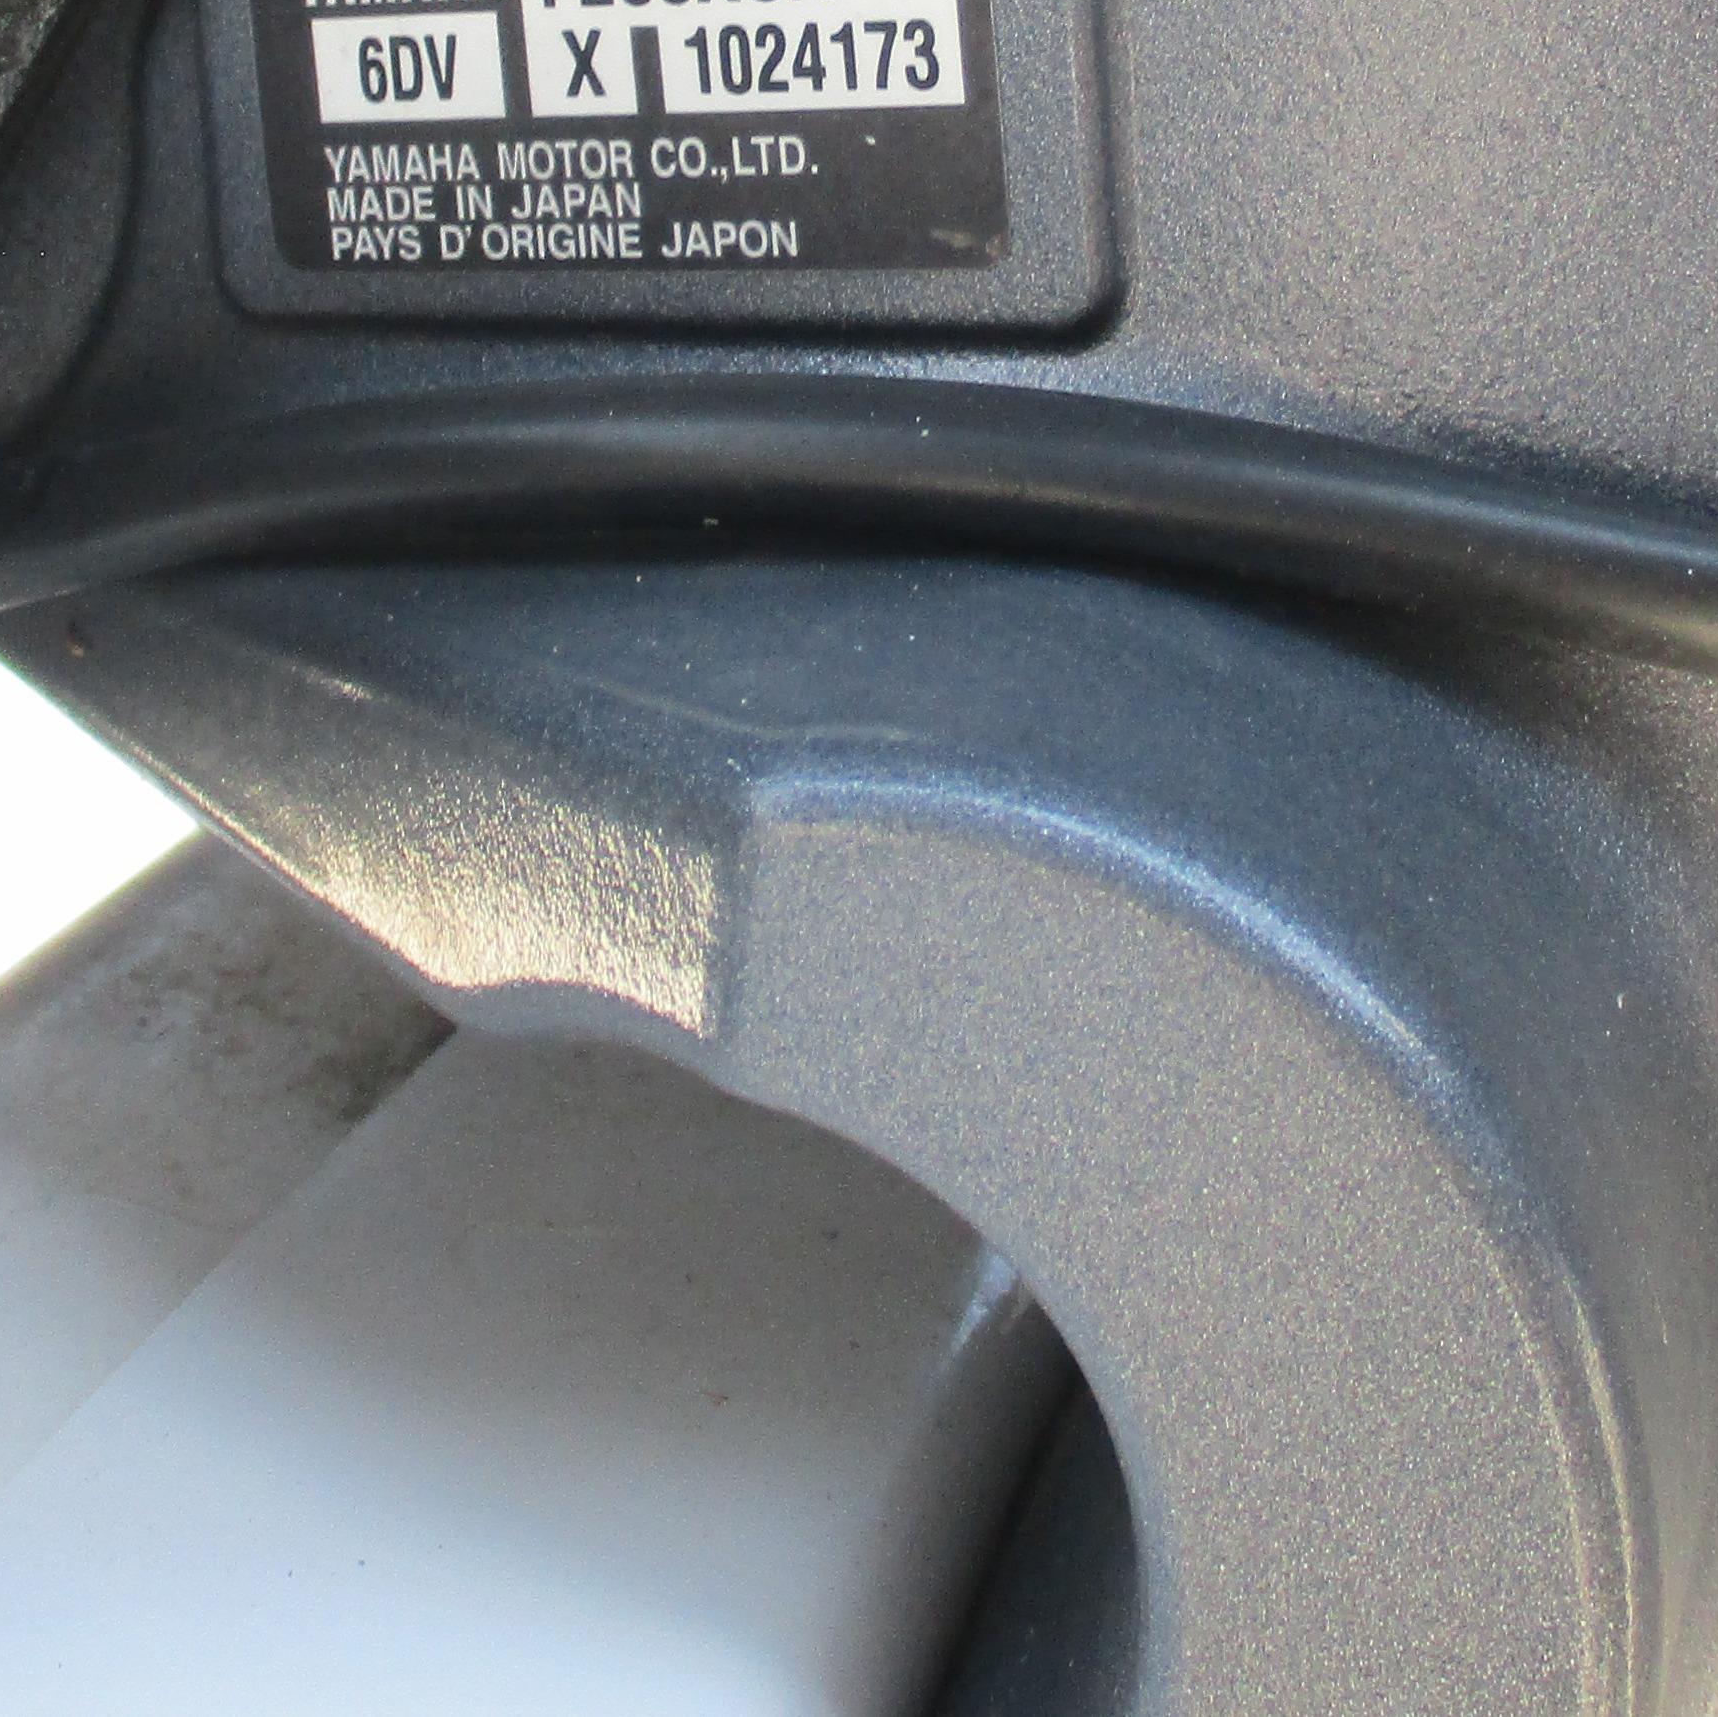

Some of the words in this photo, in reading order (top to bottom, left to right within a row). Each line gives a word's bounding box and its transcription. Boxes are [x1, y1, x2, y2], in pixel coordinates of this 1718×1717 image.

[358, 34, 457, 102] 6DV
[565, 29, 604, 98] X
[684, 19, 940, 94] 1024173
[325, 140, 480, 184] YAMAHA
[498, 140, 634, 180] MOTOR
[651, 136, 819, 180] CO.,LTD.
[327, 185, 434, 222] MADE
[456, 184, 494, 220] IN
[512, 183, 641, 219] JAPAN
[331, 226, 422, 261] PAYS
[440, 224, 642, 260] D'ORIGINE
[661, 221, 798, 258] JAPON
